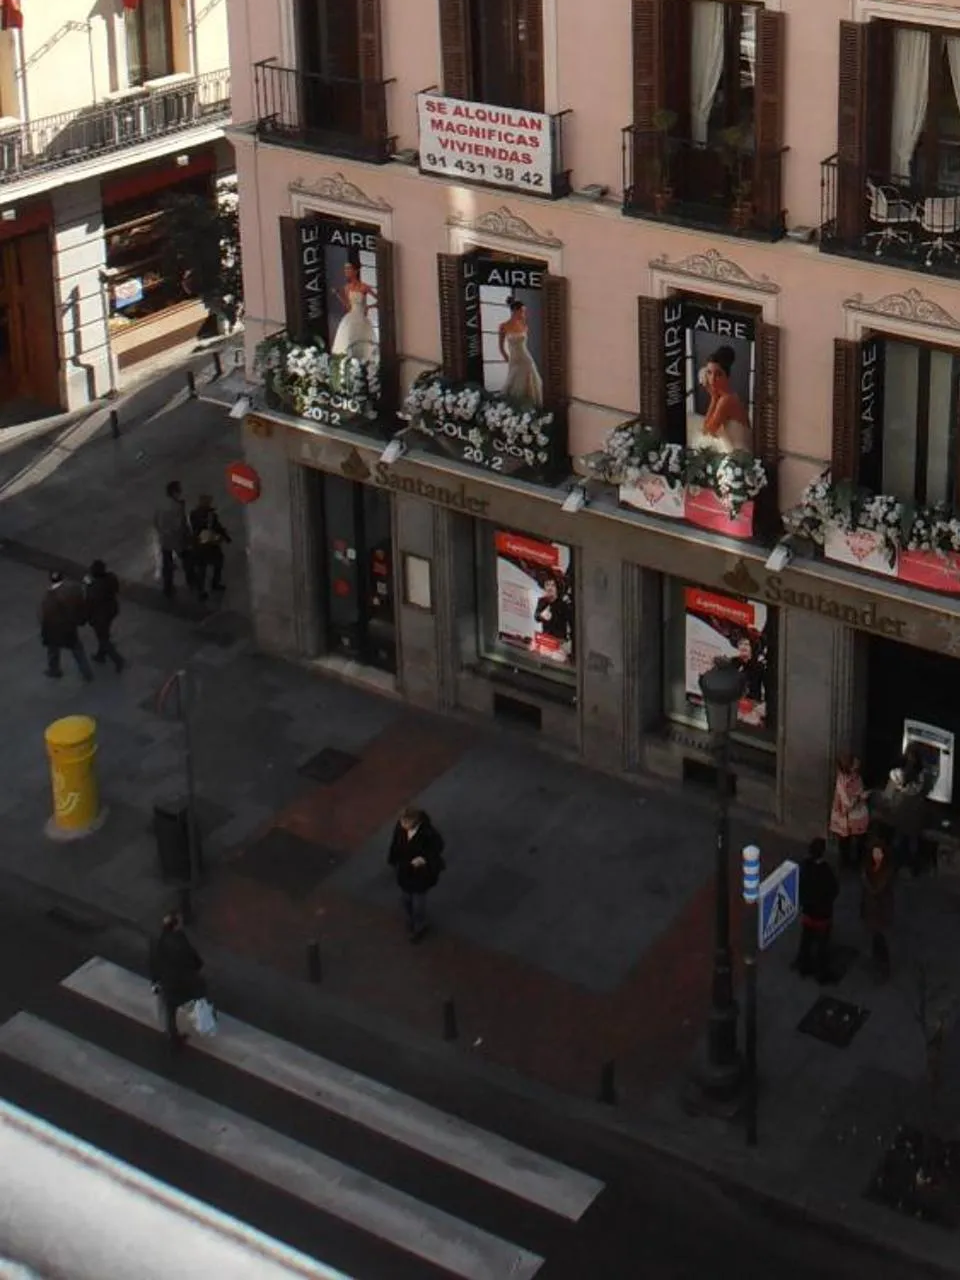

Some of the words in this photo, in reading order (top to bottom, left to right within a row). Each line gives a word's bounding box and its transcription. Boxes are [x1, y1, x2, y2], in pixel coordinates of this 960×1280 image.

[425, 100, 447, 115] SE
[452, 105, 542, 131] ALQUILAN
[431, 119, 540, 148] MAGNIFICAS
[438, 137, 533, 165] VIVIENDAS
[426, 153, 446, 167] 91
[454, 159, 485, 175] 431
[493, 166, 514, 181] 38
[520, 171, 543, 186] 42
[331, 229, 377, 250] AIRE
[301, 225, 321, 292] AIRE
[487, 268, 544, 288] AIRE
[664, 303, 682, 377] AIRE
[694, 314, 747, 340] AIRE
[861, 343, 877, 422] AIRE
[463, 446, 503, 470] 202
[374, 462, 490, 513] Santander
[764, 575, 906, 635] Santander
